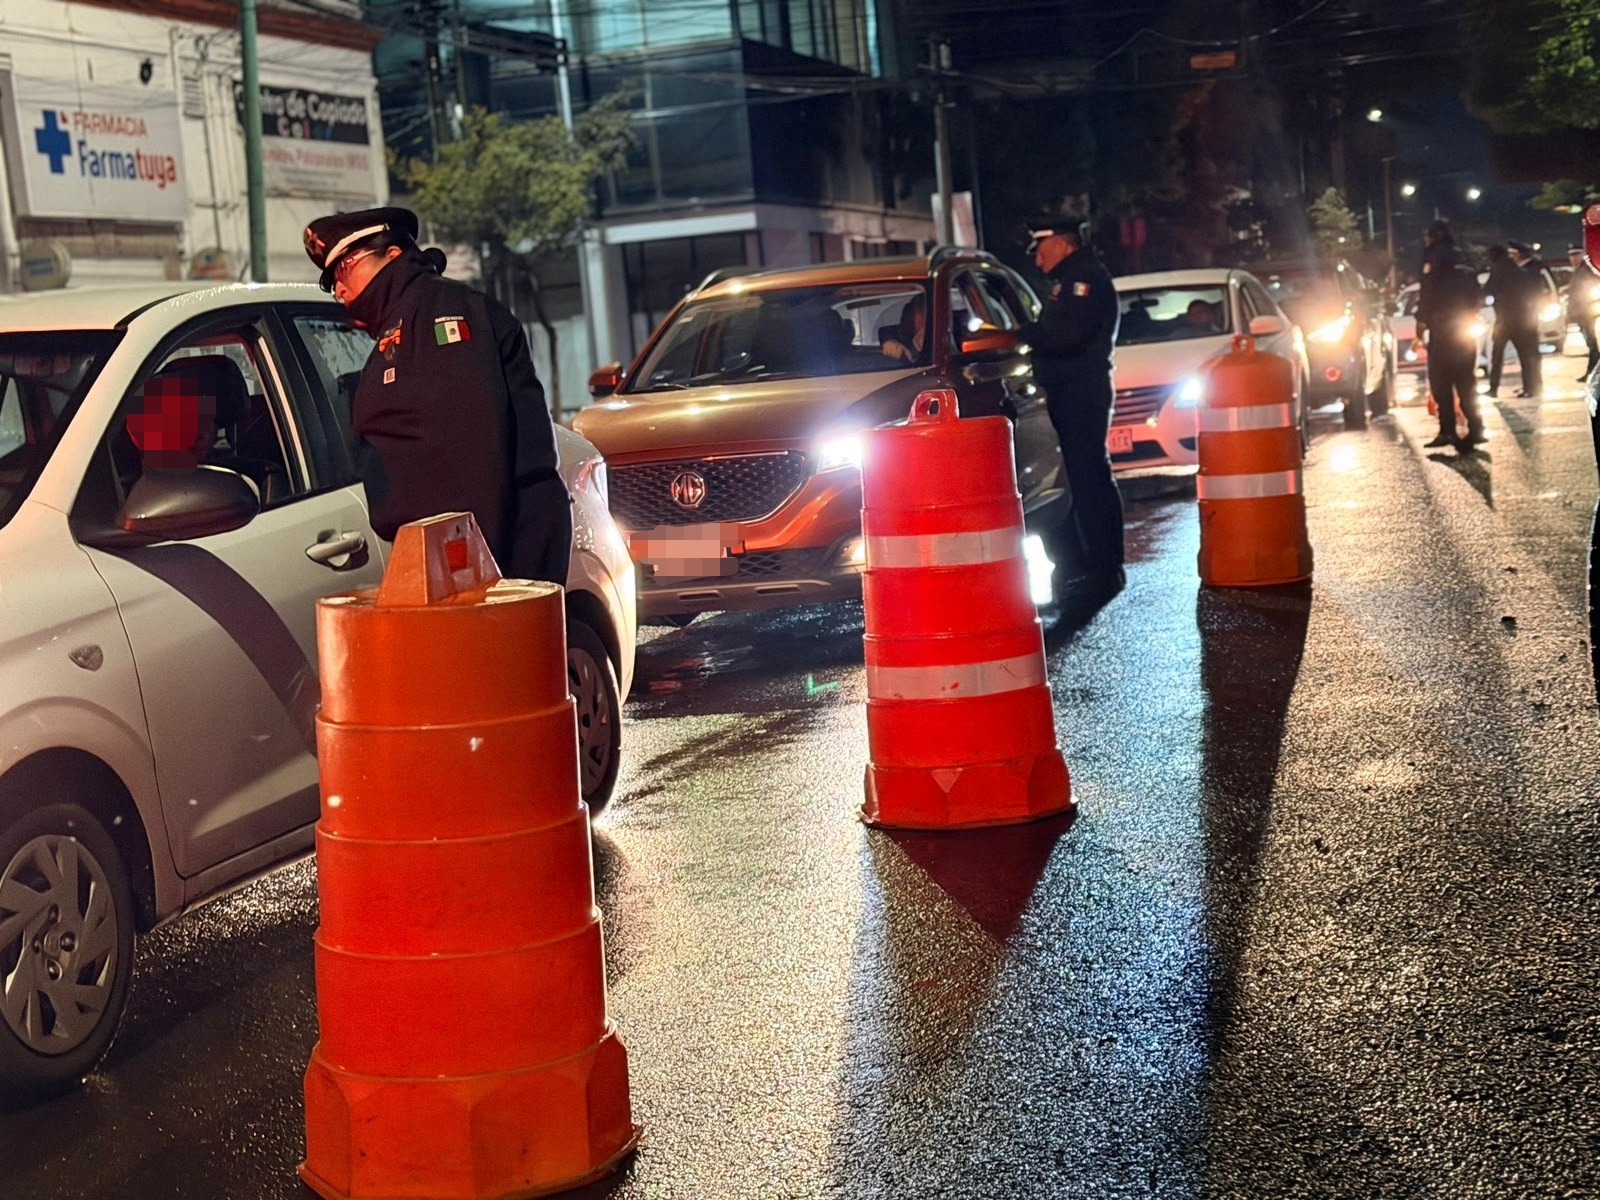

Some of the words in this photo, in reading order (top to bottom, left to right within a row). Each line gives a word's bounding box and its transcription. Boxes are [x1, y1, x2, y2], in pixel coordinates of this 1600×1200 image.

[285, 89, 307, 119] de
[73, 111, 148, 137] FARMACIA
[78, 139, 176, 190] Farmatuya
[673, 473, 704, 505] MG
